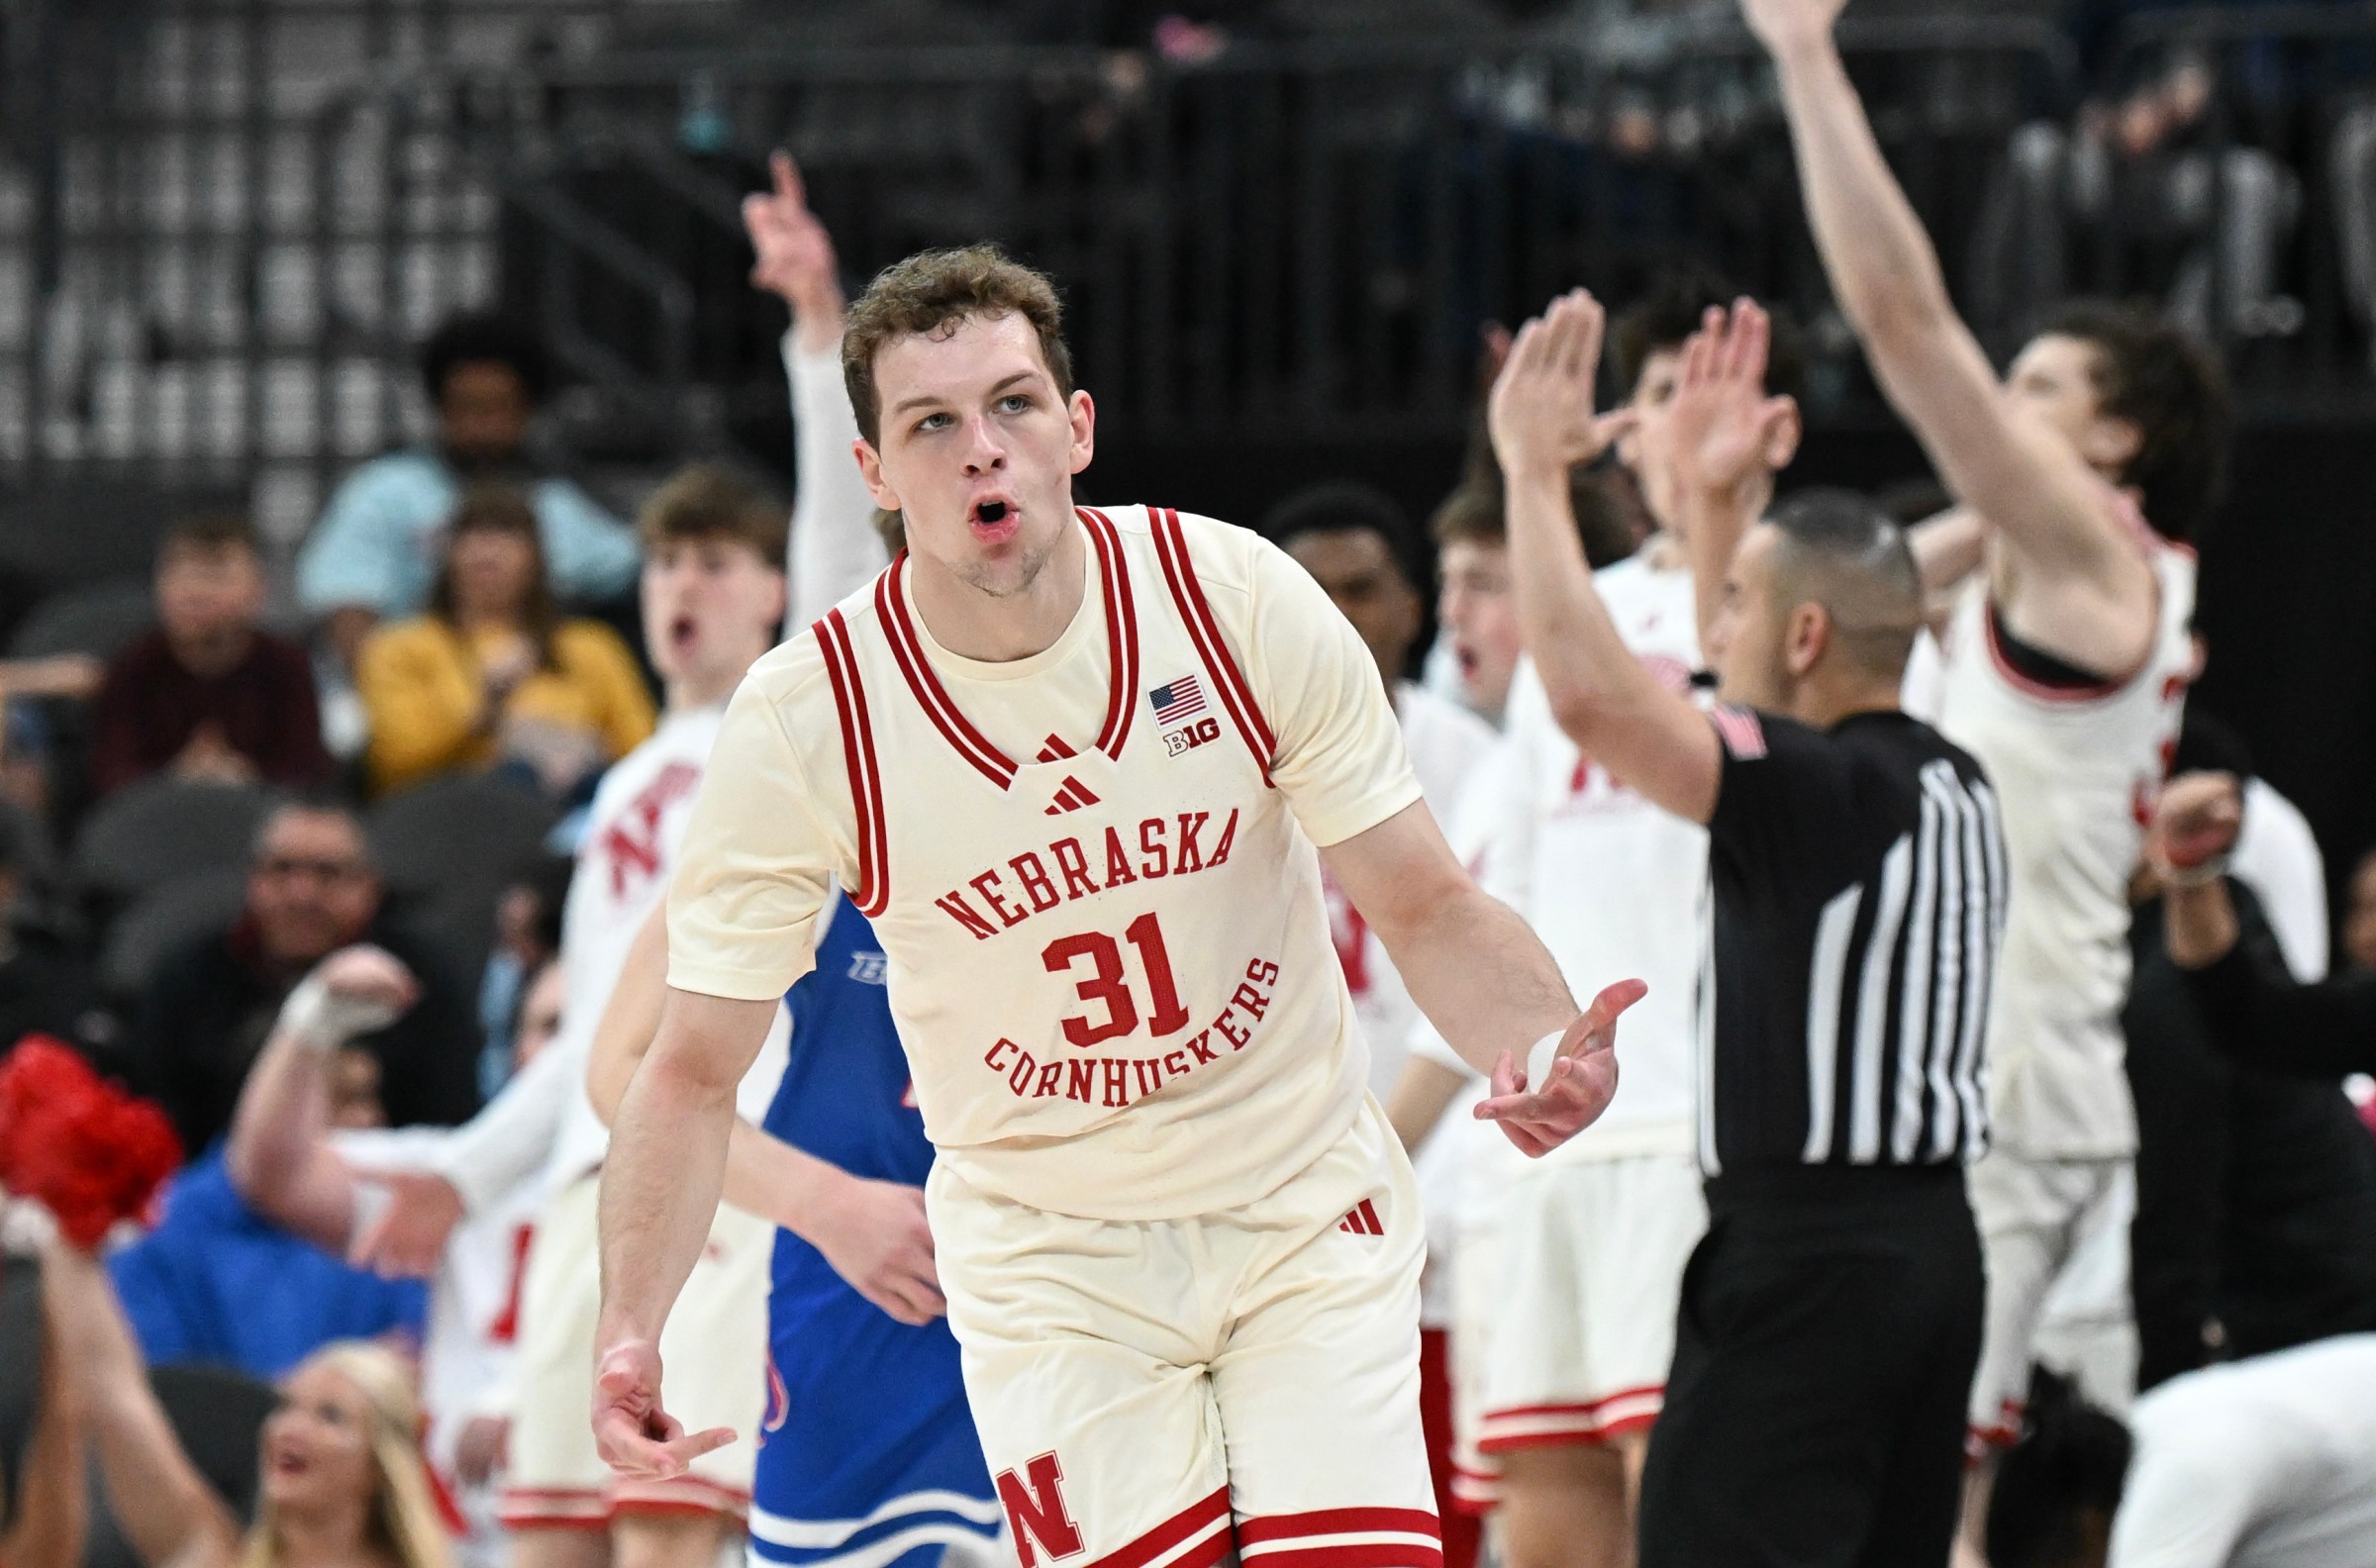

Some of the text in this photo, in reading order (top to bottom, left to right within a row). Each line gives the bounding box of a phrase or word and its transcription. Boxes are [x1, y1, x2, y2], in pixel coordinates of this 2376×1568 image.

[934, 808, 1238, 940] NEBRASKA
[984, 957, 1279, 1108] CORNHUSKERS
[1040, 911, 1190, 1048] 31
[995, 1449, 1086, 1568] N
